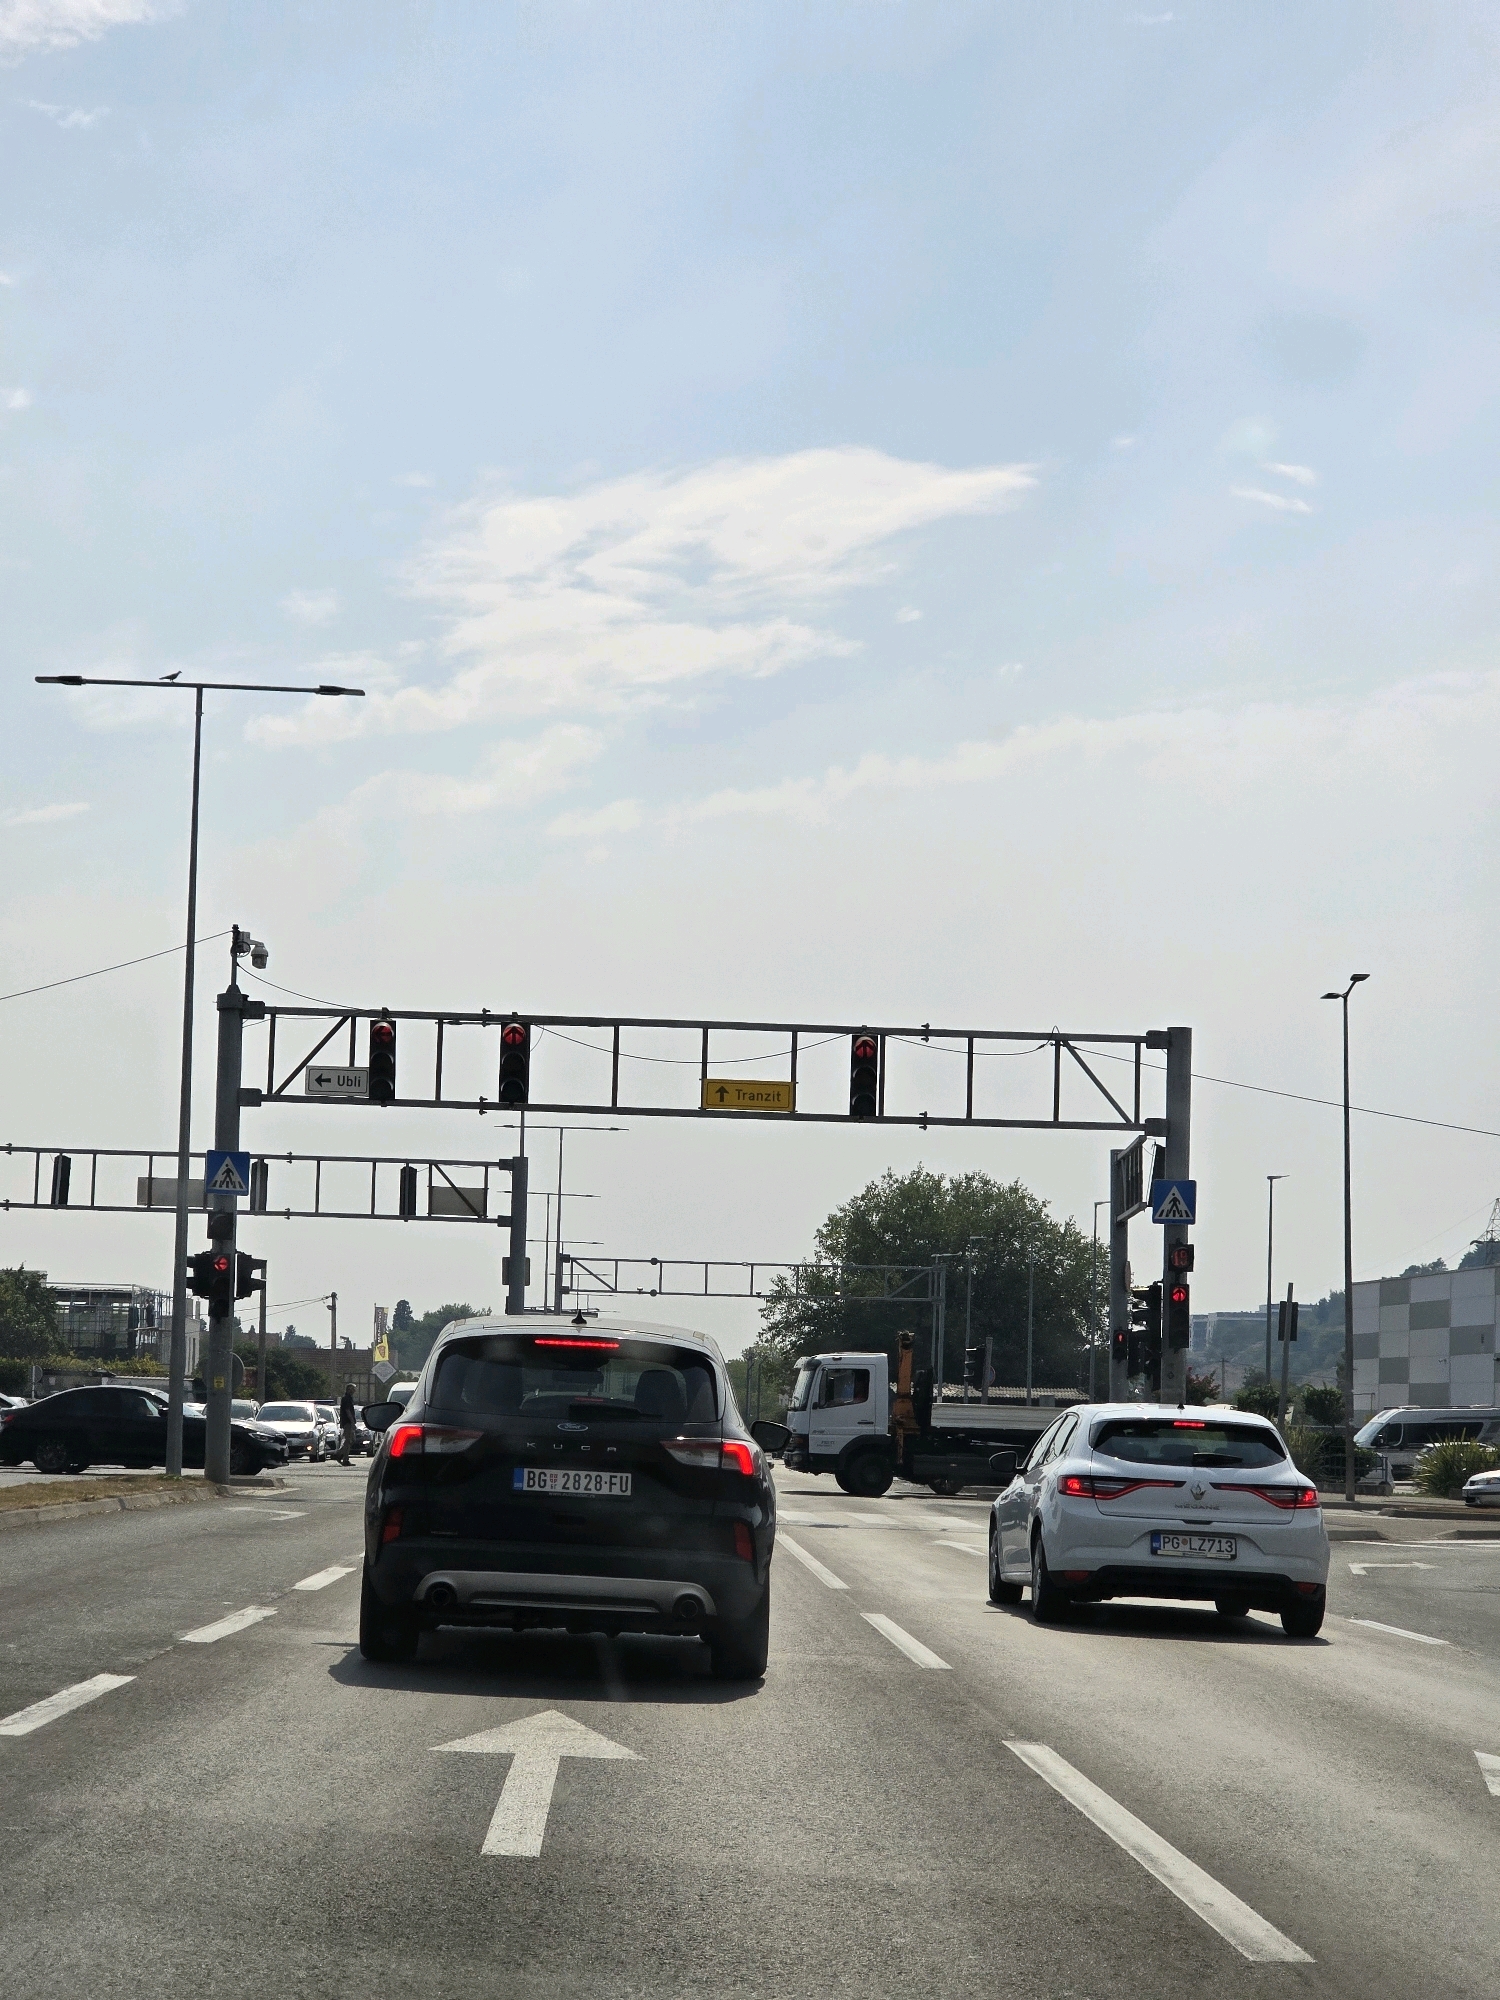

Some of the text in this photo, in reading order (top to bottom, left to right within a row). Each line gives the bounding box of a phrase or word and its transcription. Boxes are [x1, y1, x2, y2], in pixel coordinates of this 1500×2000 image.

[337, 1075, 361, 1087] Ubli
[735, 1088, 782, 1102] Tranzit
[526, 1470, 547, 1489] BG
[1162, 1535, 1180, 1549] PG
[1189, 1537, 1234, 1553] LZ713
